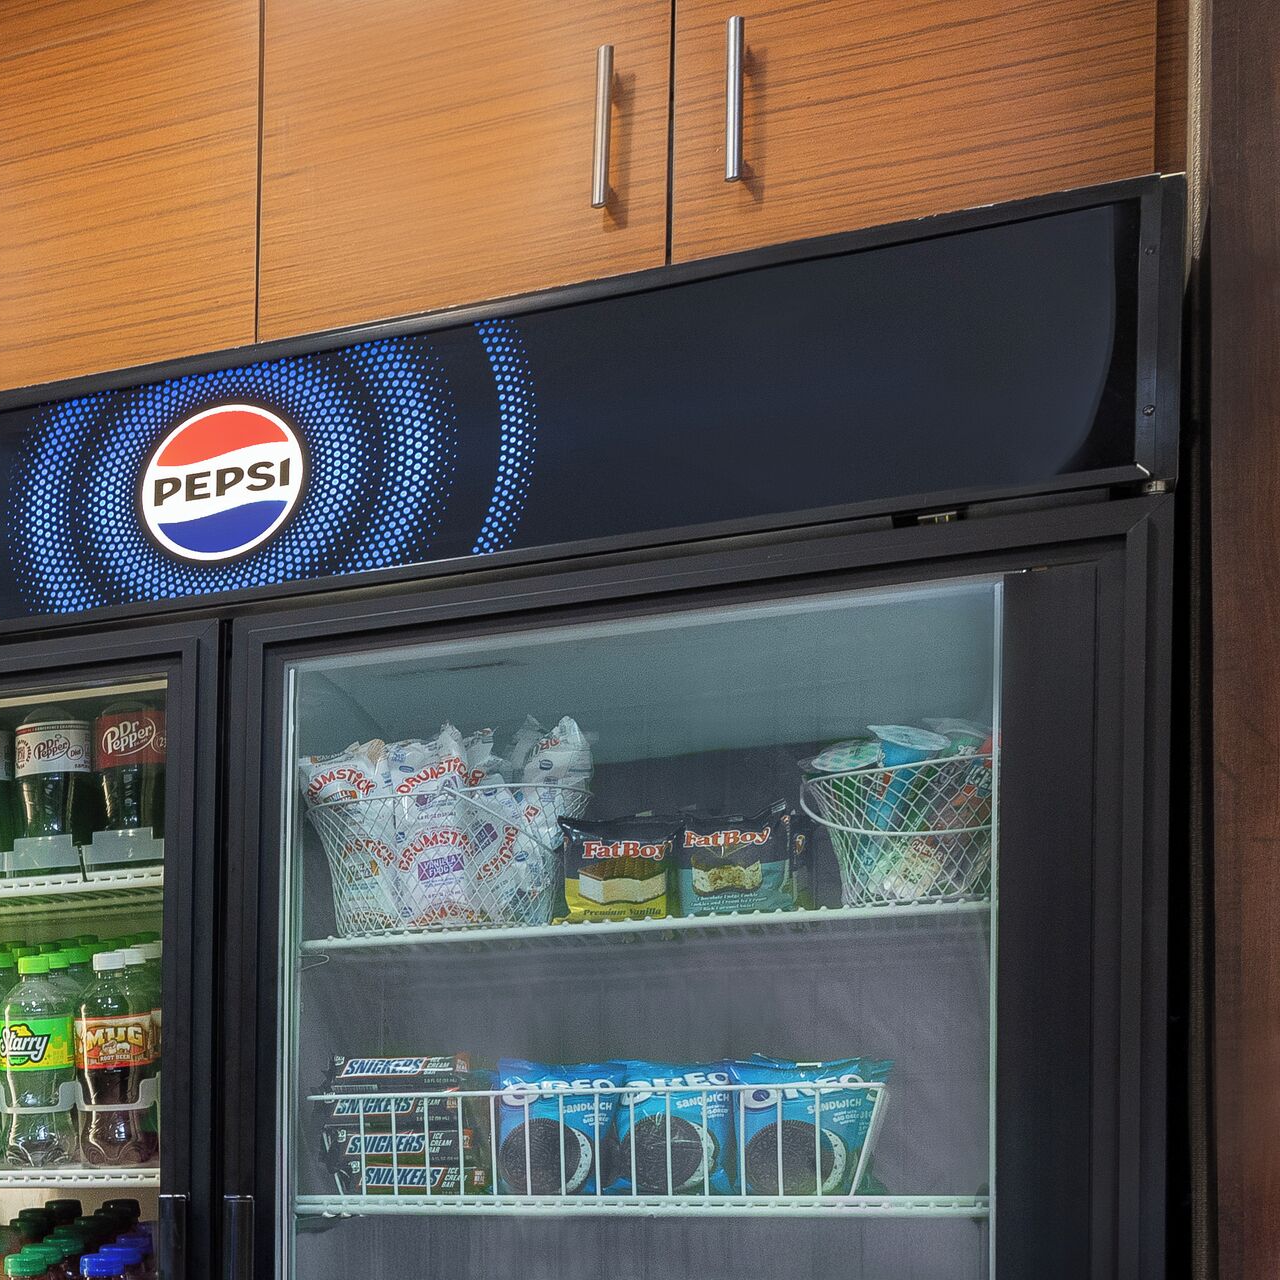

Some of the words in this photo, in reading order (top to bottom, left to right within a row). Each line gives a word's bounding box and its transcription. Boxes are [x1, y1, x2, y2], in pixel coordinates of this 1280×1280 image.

[154, 457, 290, 506] PEPSI
[106, 725, 152, 754] Pepper
[119, 721, 139, 736] Dr
[0, 1026, 49, 1063] Starry
[85, 1026, 144, 1047] MUG
